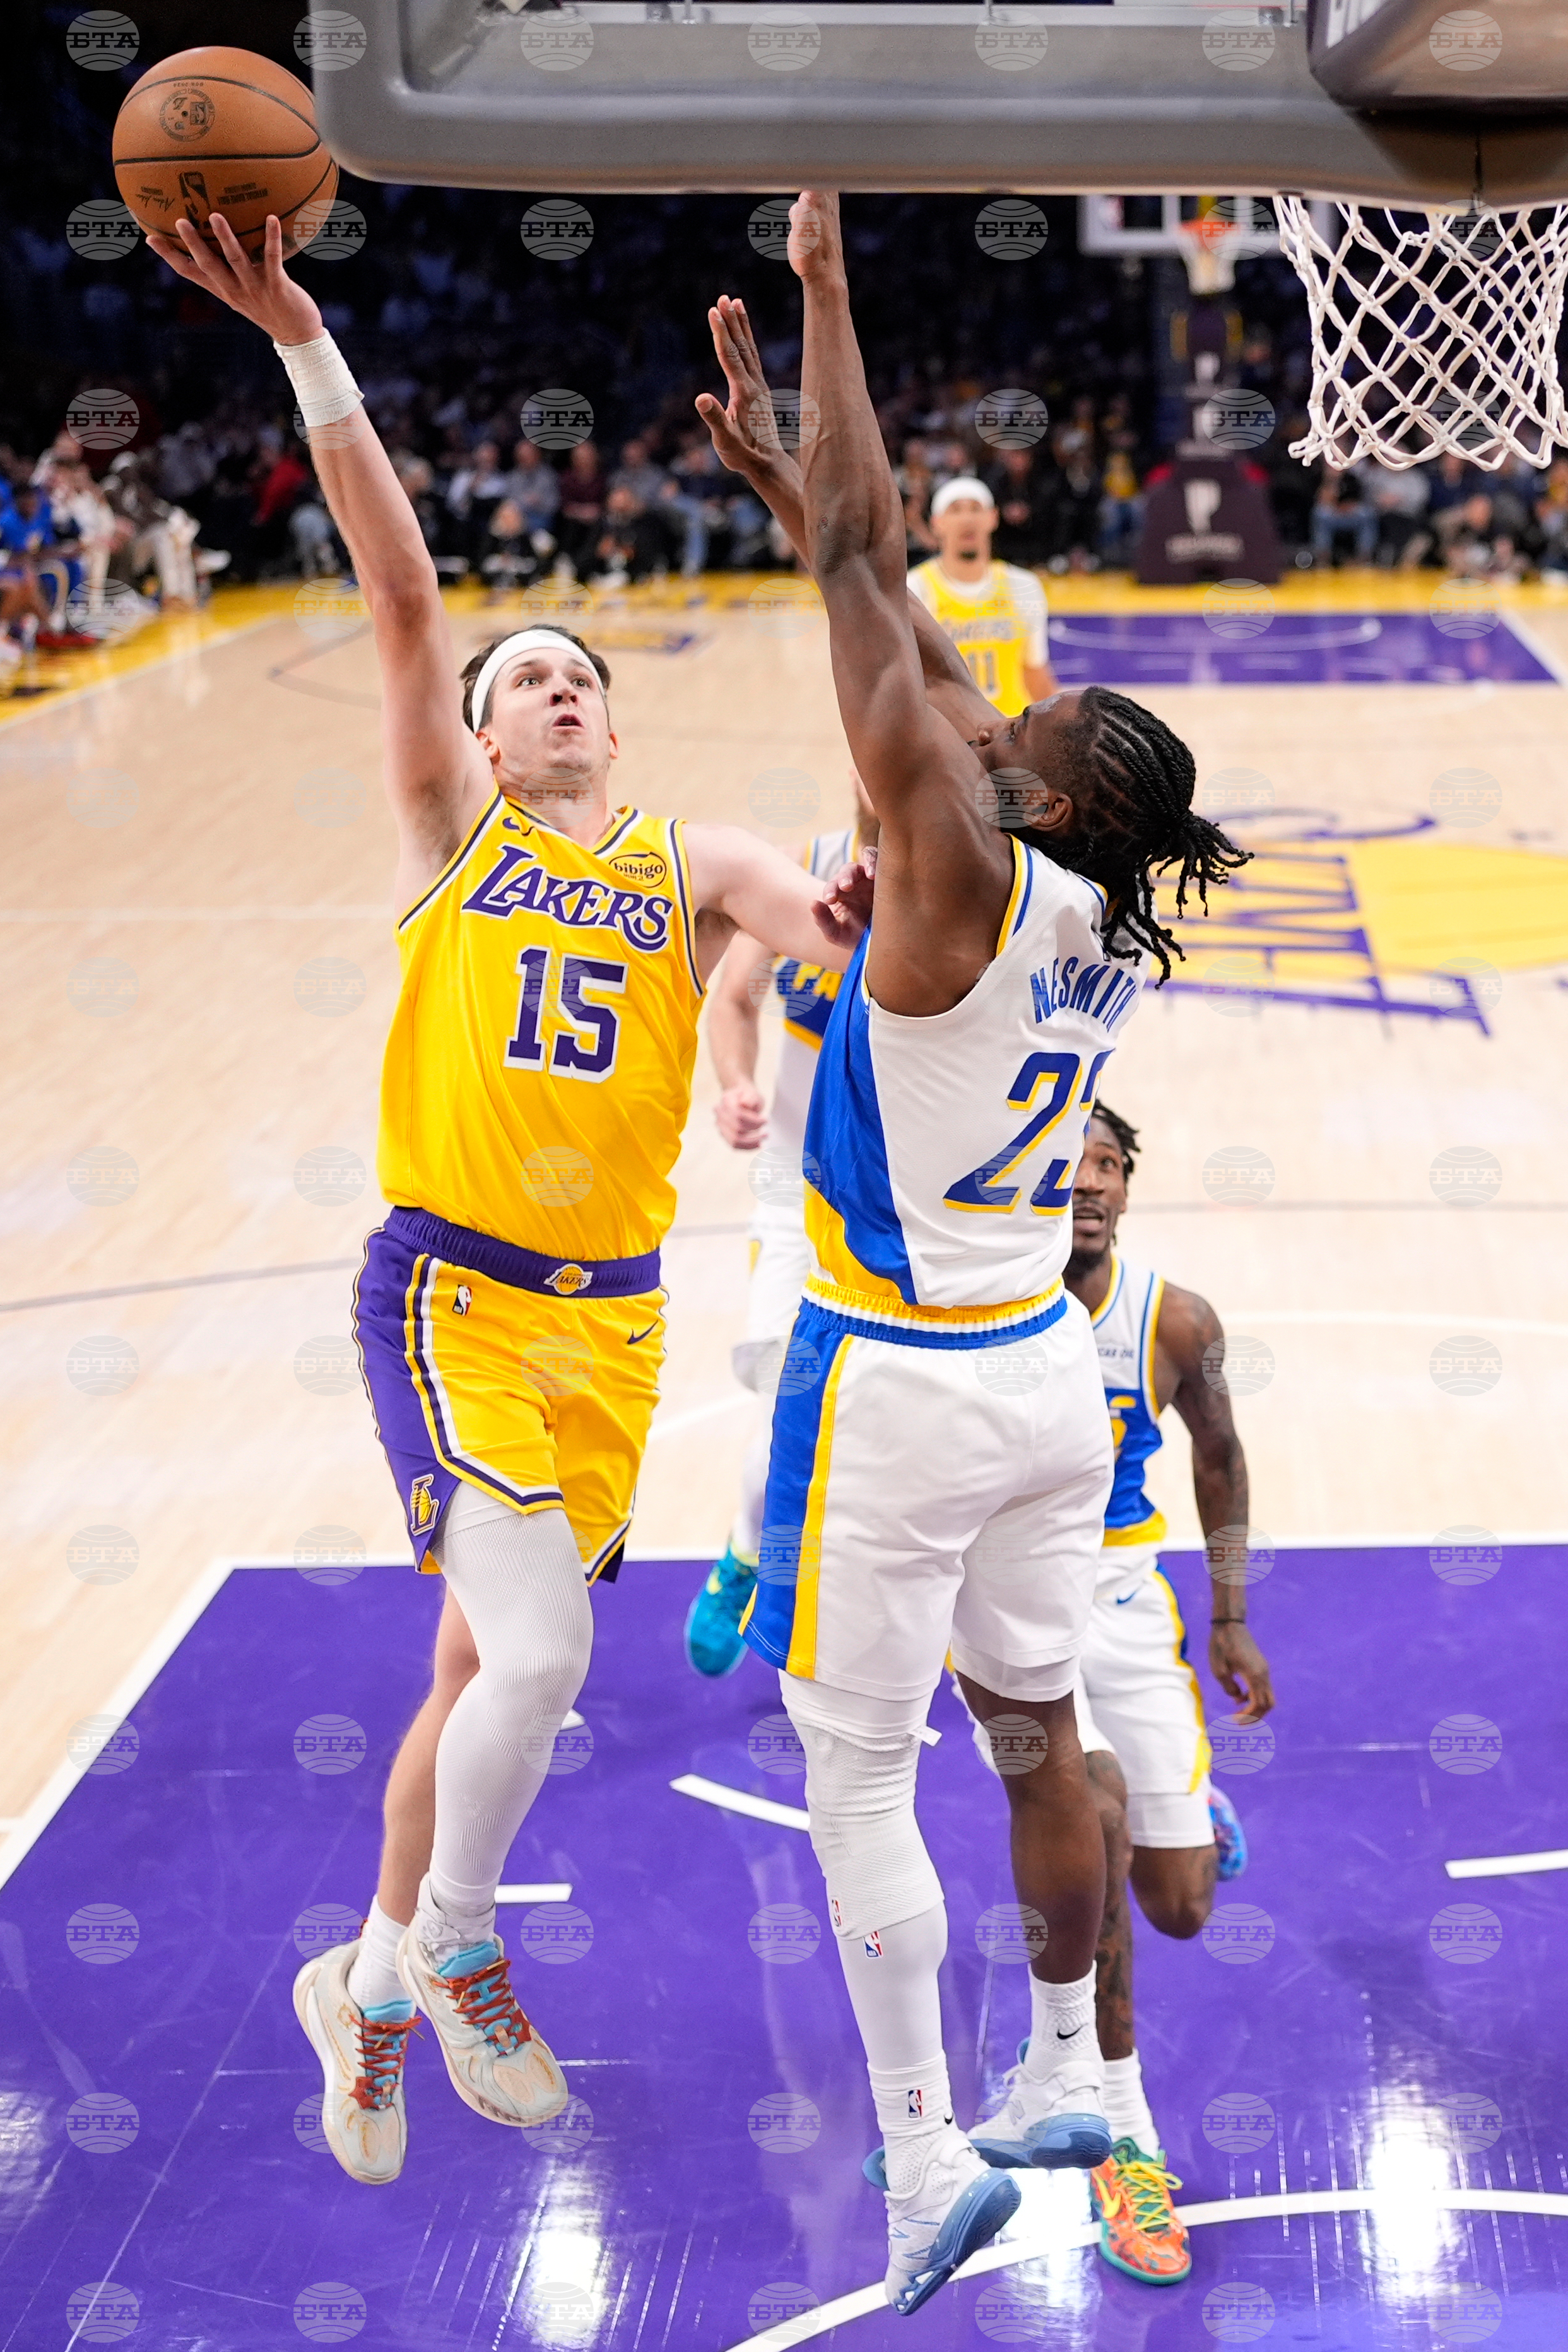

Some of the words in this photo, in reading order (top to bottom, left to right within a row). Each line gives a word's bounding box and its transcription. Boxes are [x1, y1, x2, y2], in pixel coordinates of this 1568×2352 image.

[461, 844, 674, 952] LAKERS
[614, 863, 663, 879] bibigo
[504, 946, 629, 1084] 15
[1030, 957, 1136, 1033] NESMITH
